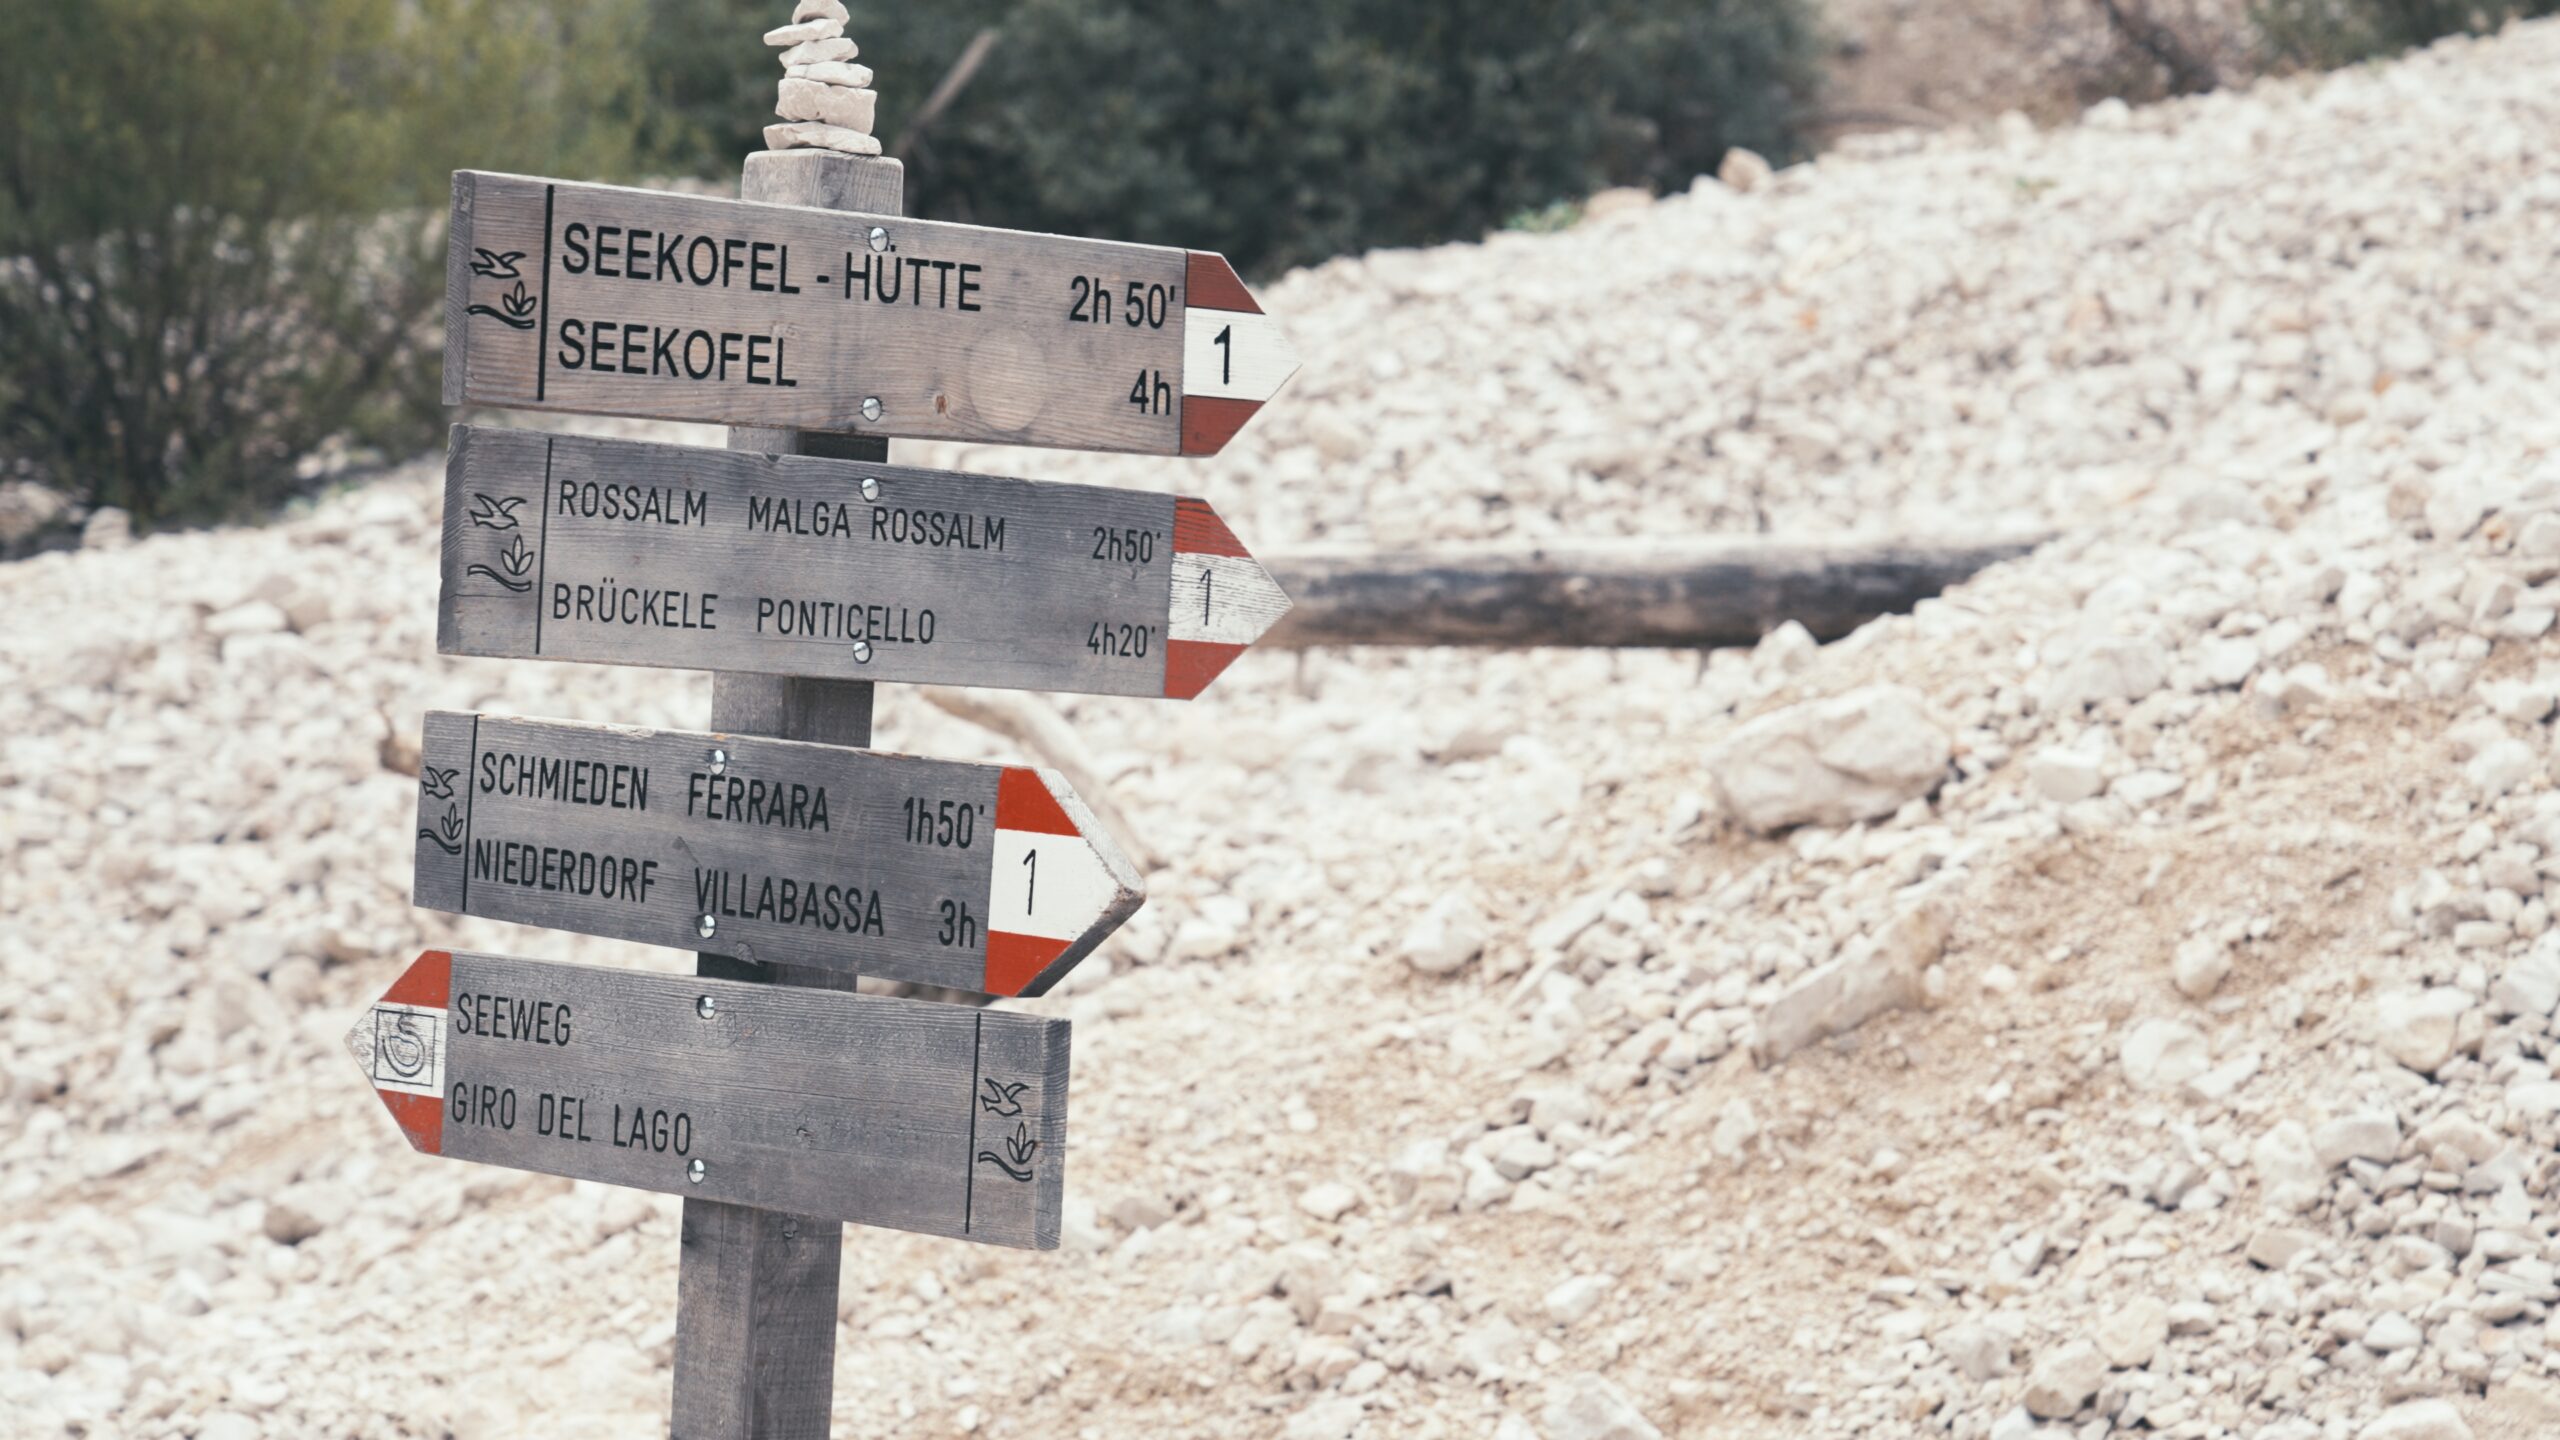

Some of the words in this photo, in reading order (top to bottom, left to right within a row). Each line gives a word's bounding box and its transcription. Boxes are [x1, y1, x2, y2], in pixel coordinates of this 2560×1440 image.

[562, 222, 801, 294] SEEKOFEL
[844, 243, 983, 312] HÜTTE
[1069, 275, 1112, 324] 2h
[558, 318, 797, 387] SEEKOFEL
[1214, 324, 1231, 385] 1
[1129, 369, 1171, 416] 4h
[558, 479, 708, 527] ROSSALM
[748, 495, 851, 538] MALGA
[871, 505, 1006, 552] ROSSALM
[1092, 525, 1162, 564] 2h50'
[552, 577, 719, 630] BRÜCKELE
[757, 597, 936, 646] PONTICELLO
[1199, 568, 1212, 626] 1
[1087, 621, 1157, 659] 4h20'
[480, 751, 649, 811] SCHMIEDEN
[688, 772, 830, 832] FERRARA
[903, 795, 985, 849] 1h50'
[474, 838, 658, 903] NIEDERDORF
[694, 866, 885, 937] VILLABASSA
[1023, 848, 1037, 916] 1
[938, 899, 977, 949] 3h
[456, 992, 572, 1047] SEEWEG
[451, 1081, 517, 1131] GIRO
[538, 1093, 592, 1143] DEL
[613, 1103, 692, 1156] LAGO
